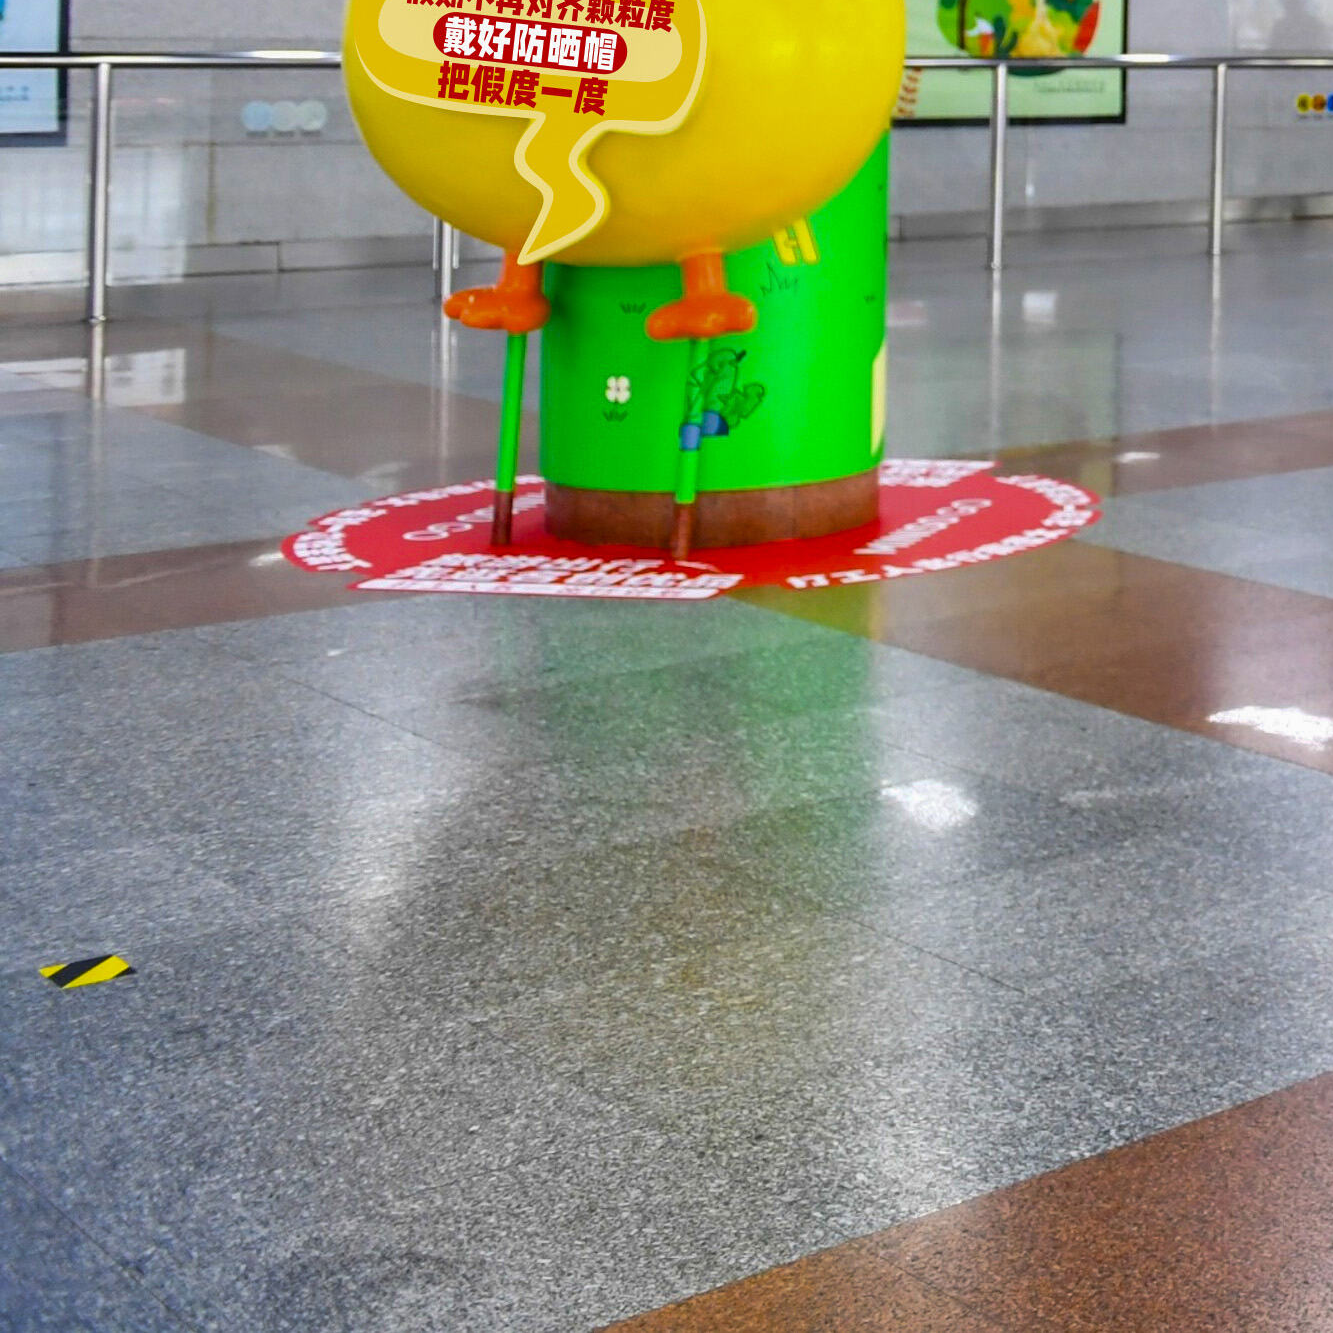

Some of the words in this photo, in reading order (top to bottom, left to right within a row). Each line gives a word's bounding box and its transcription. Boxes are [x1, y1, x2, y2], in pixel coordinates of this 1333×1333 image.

[443, 15, 618, 72] 戴好防晒帽
[437, 60, 609, 117] 把假度一度
